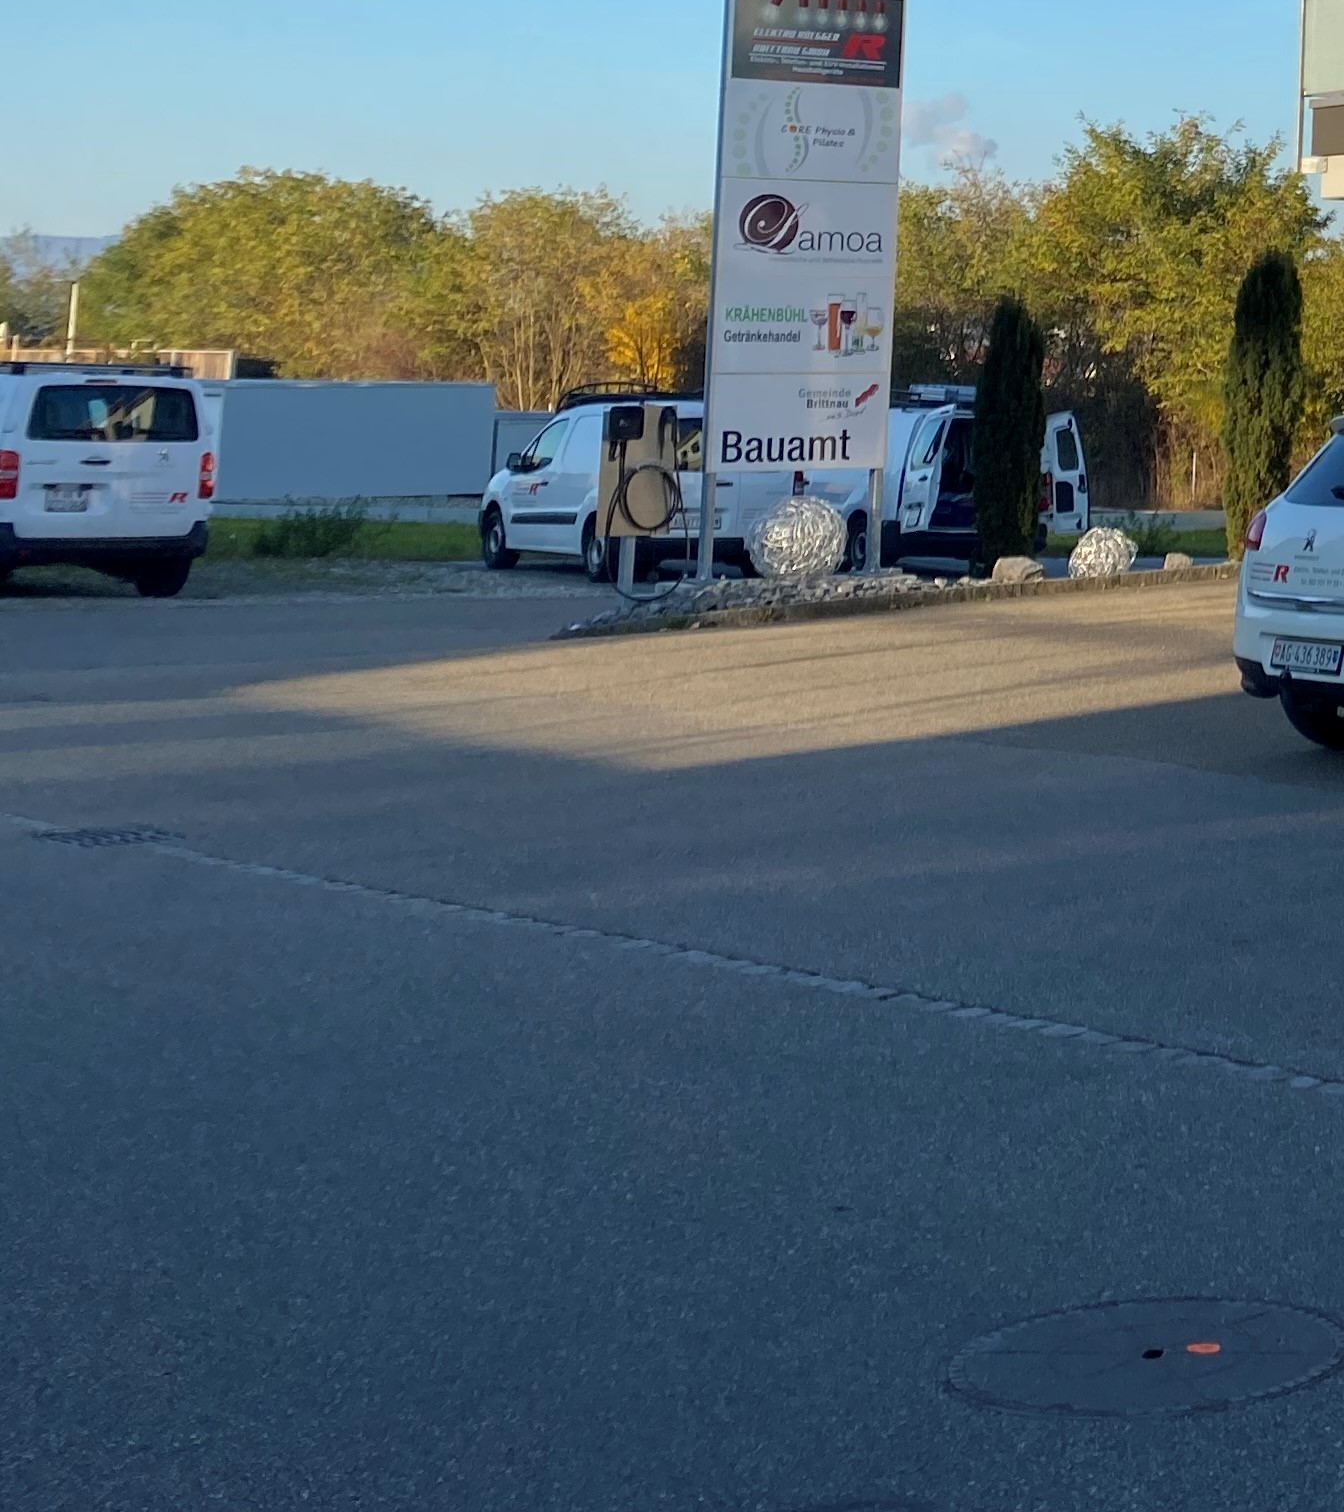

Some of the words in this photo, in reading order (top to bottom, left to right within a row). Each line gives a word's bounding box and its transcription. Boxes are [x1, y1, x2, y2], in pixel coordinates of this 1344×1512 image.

[812, 138, 845, 148] Pilates
[725, 305, 808, 323] KRÄHENBÜHL
[723, 329, 801, 343] Getränkehandel
[798, 388, 851, 399] Gemeinde
[806, 399, 849, 409] Brittnau
[721, 429, 851, 464] Bauamt
